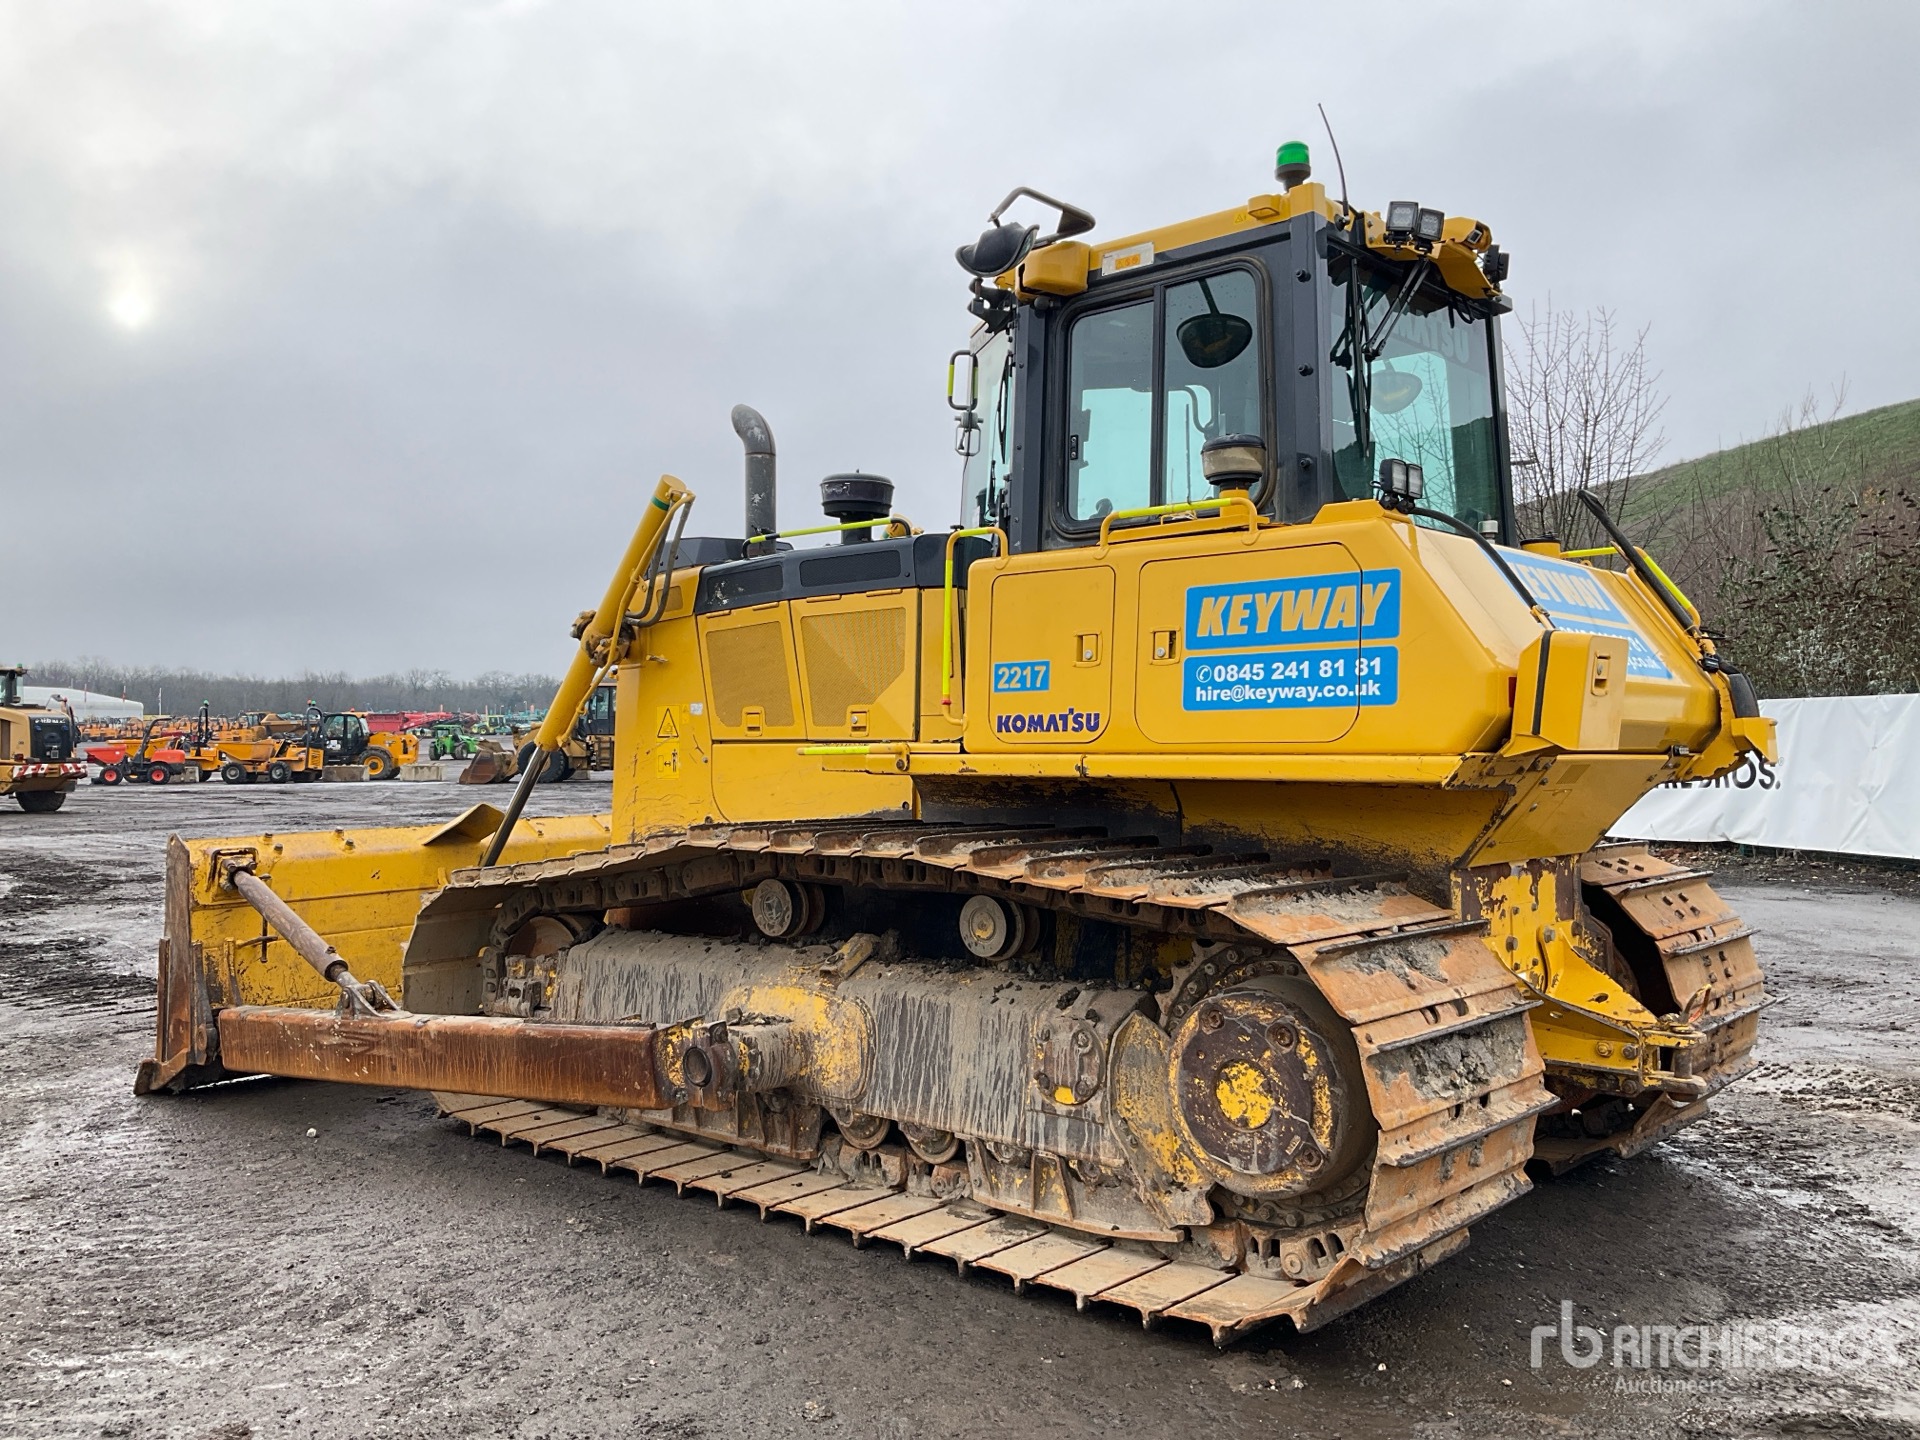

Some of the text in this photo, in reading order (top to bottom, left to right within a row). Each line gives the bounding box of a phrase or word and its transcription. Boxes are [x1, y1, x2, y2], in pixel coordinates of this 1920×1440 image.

[1196, 582, 1391, 638] KEYWAY
[997, 665, 1047, 689] 2217
[1213, 657, 1381, 683] 0845 241 81 81
[1195, 679, 1381, 704] hire@keyway.co.uk
[996, 707, 1100, 733] KOMATSU
